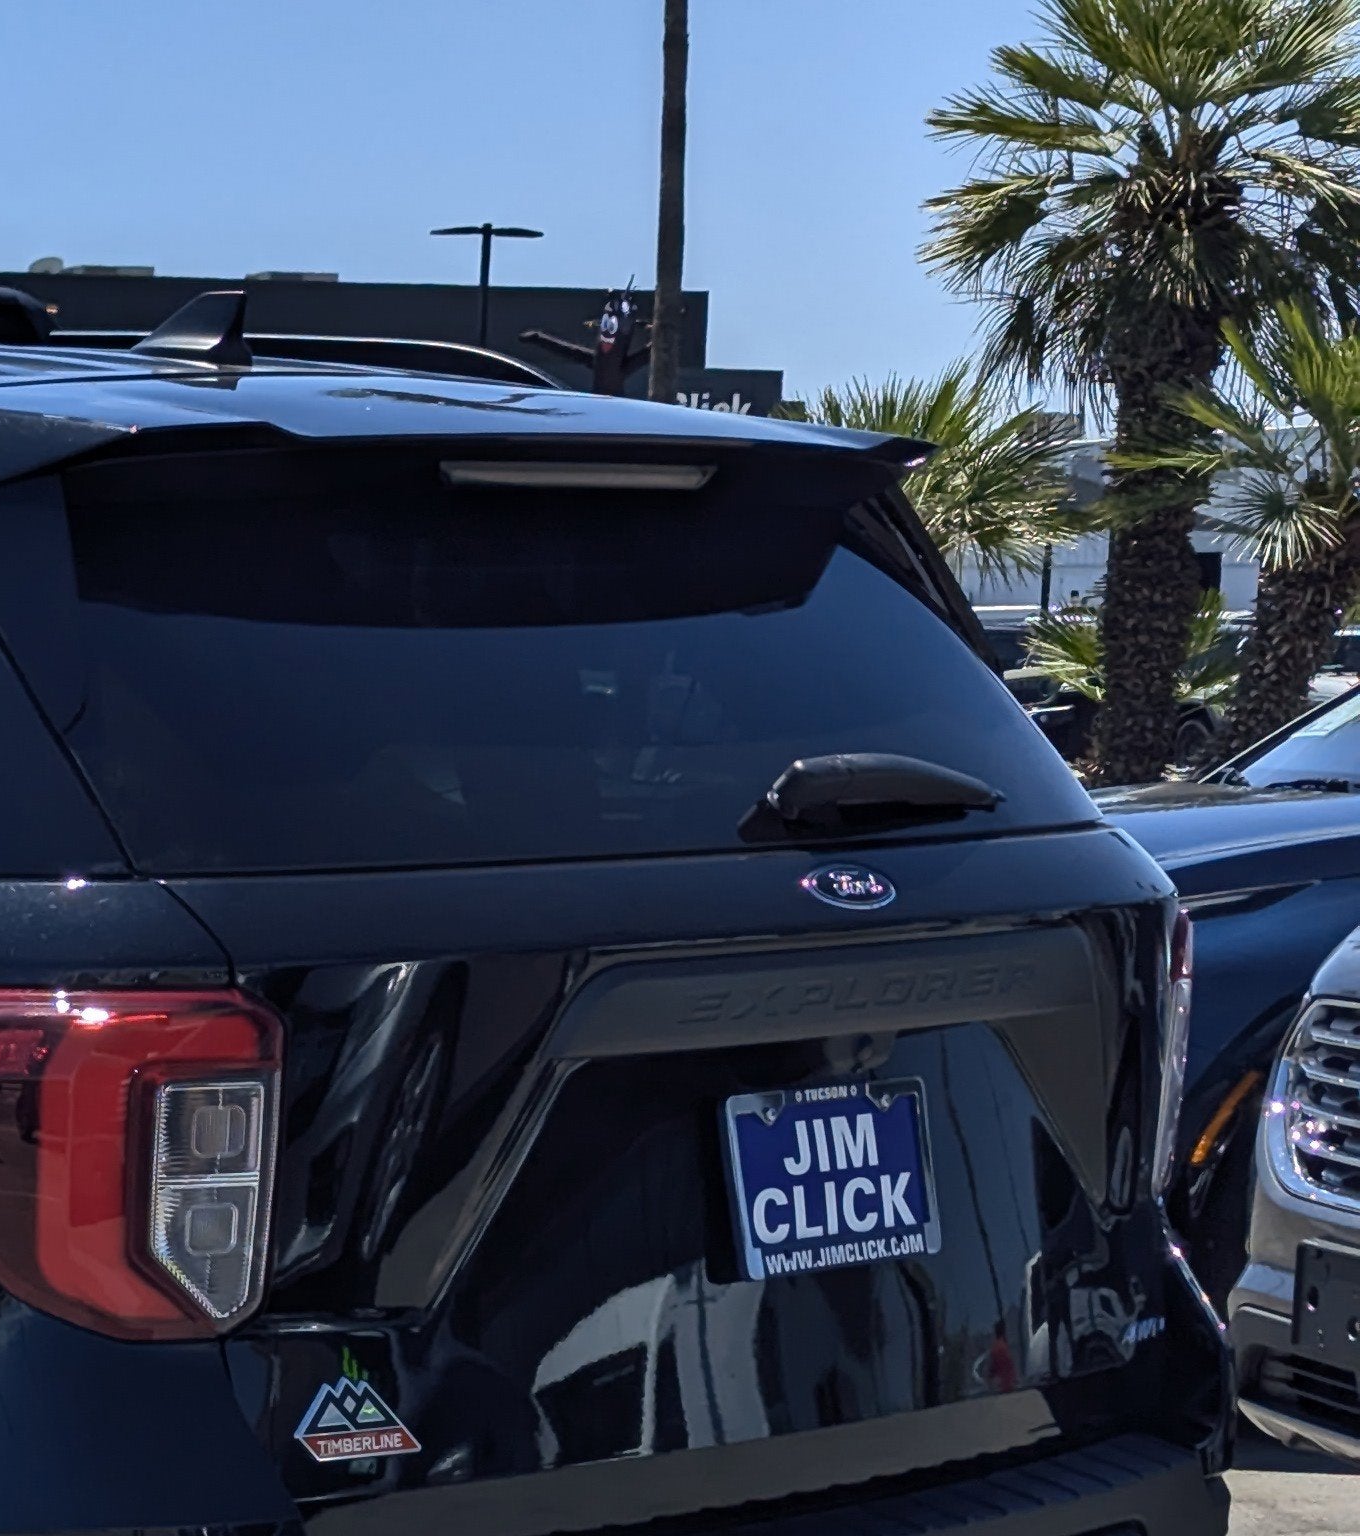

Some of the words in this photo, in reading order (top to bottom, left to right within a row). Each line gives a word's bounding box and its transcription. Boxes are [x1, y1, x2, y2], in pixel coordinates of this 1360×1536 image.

[827, 870, 884, 897] Ford
[676, 961, 1036, 1024] EXPLORER
[804, 1085, 848, 1101] TUCSON
[783, 1113, 879, 1175] JIM
[753, 1171, 917, 1244] CLICK
[765, 1233, 925, 1275] WWW.JIMCLICK.COM
[316, 1432, 403, 1456] TIMBERLINE
